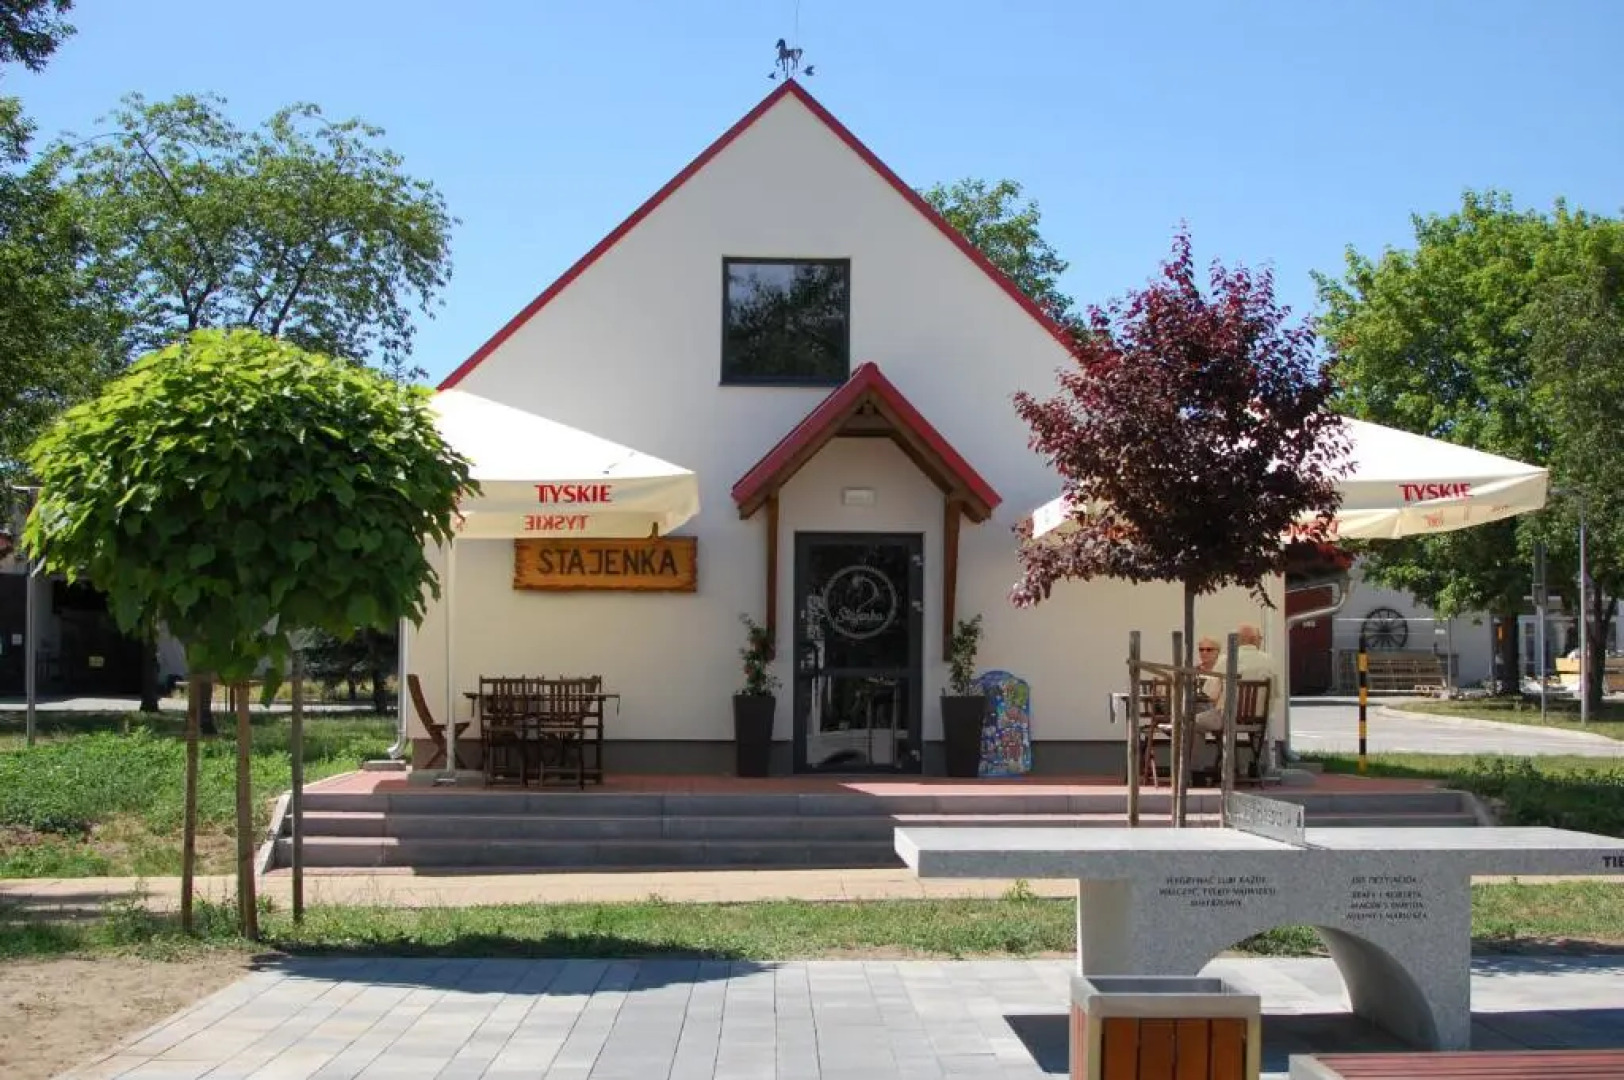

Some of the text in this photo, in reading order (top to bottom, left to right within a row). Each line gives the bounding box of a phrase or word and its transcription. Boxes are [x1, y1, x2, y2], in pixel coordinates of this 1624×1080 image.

[534, 484, 613, 504] TYSKIE
[1399, 482, 1473, 502] TYSKIE
[537, 548, 679, 576] STAJENKA
